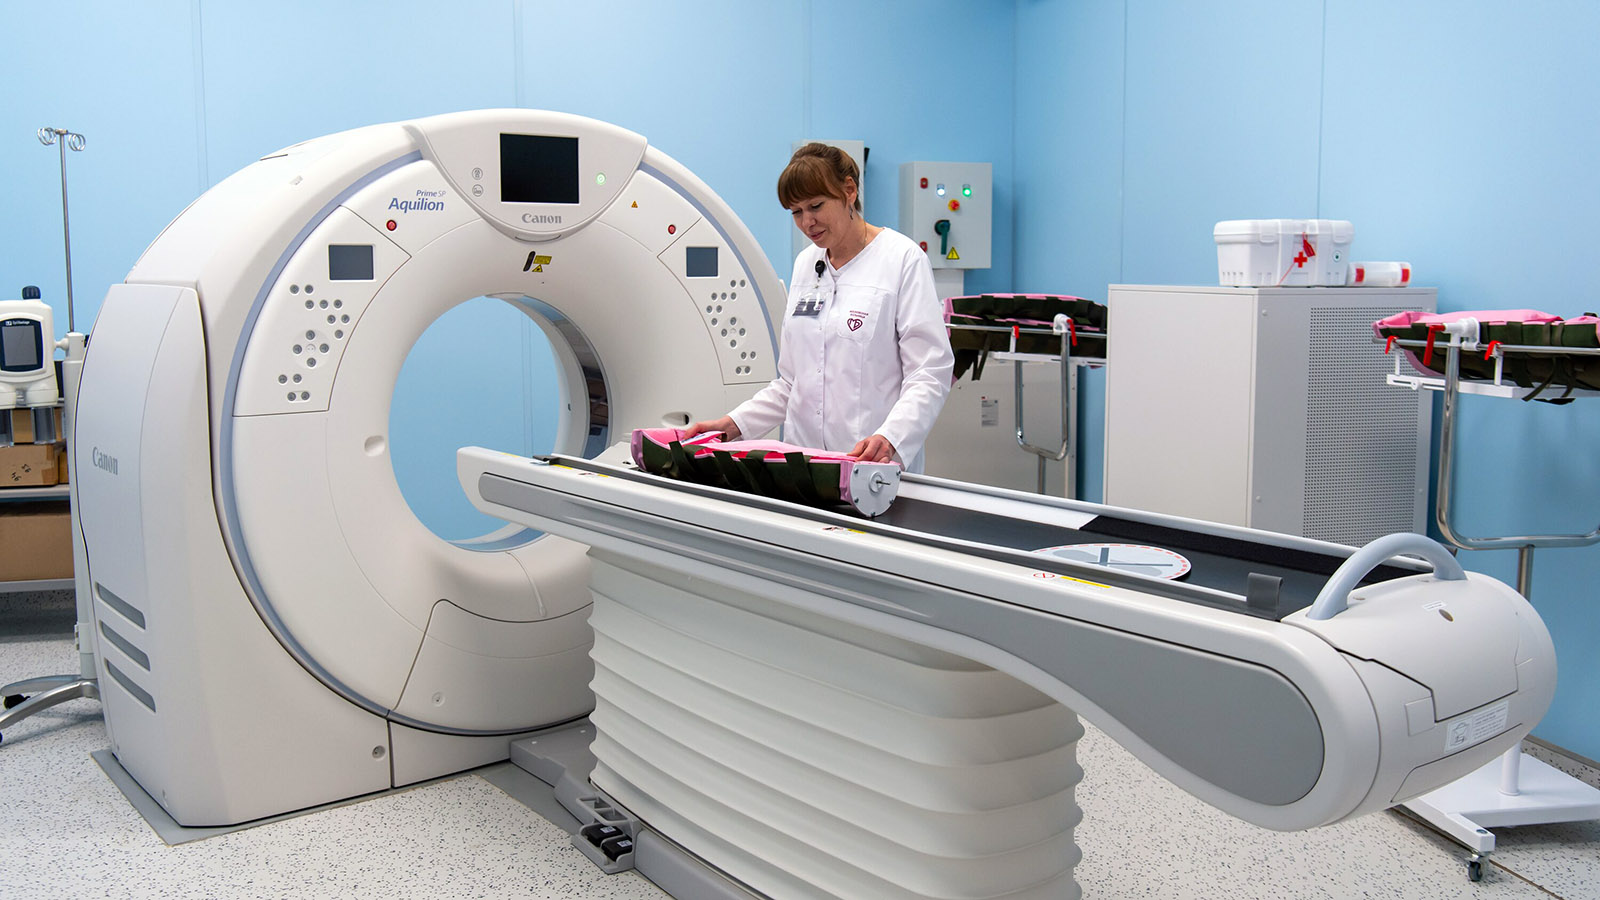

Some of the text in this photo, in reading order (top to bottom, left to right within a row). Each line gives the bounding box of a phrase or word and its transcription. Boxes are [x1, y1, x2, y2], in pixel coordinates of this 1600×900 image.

[416, 189, 446, 198] Prime SP
[388, 197, 445, 214] Aquilion
[521, 213, 562, 224] Canon
[92, 446, 118, 475] Canon
